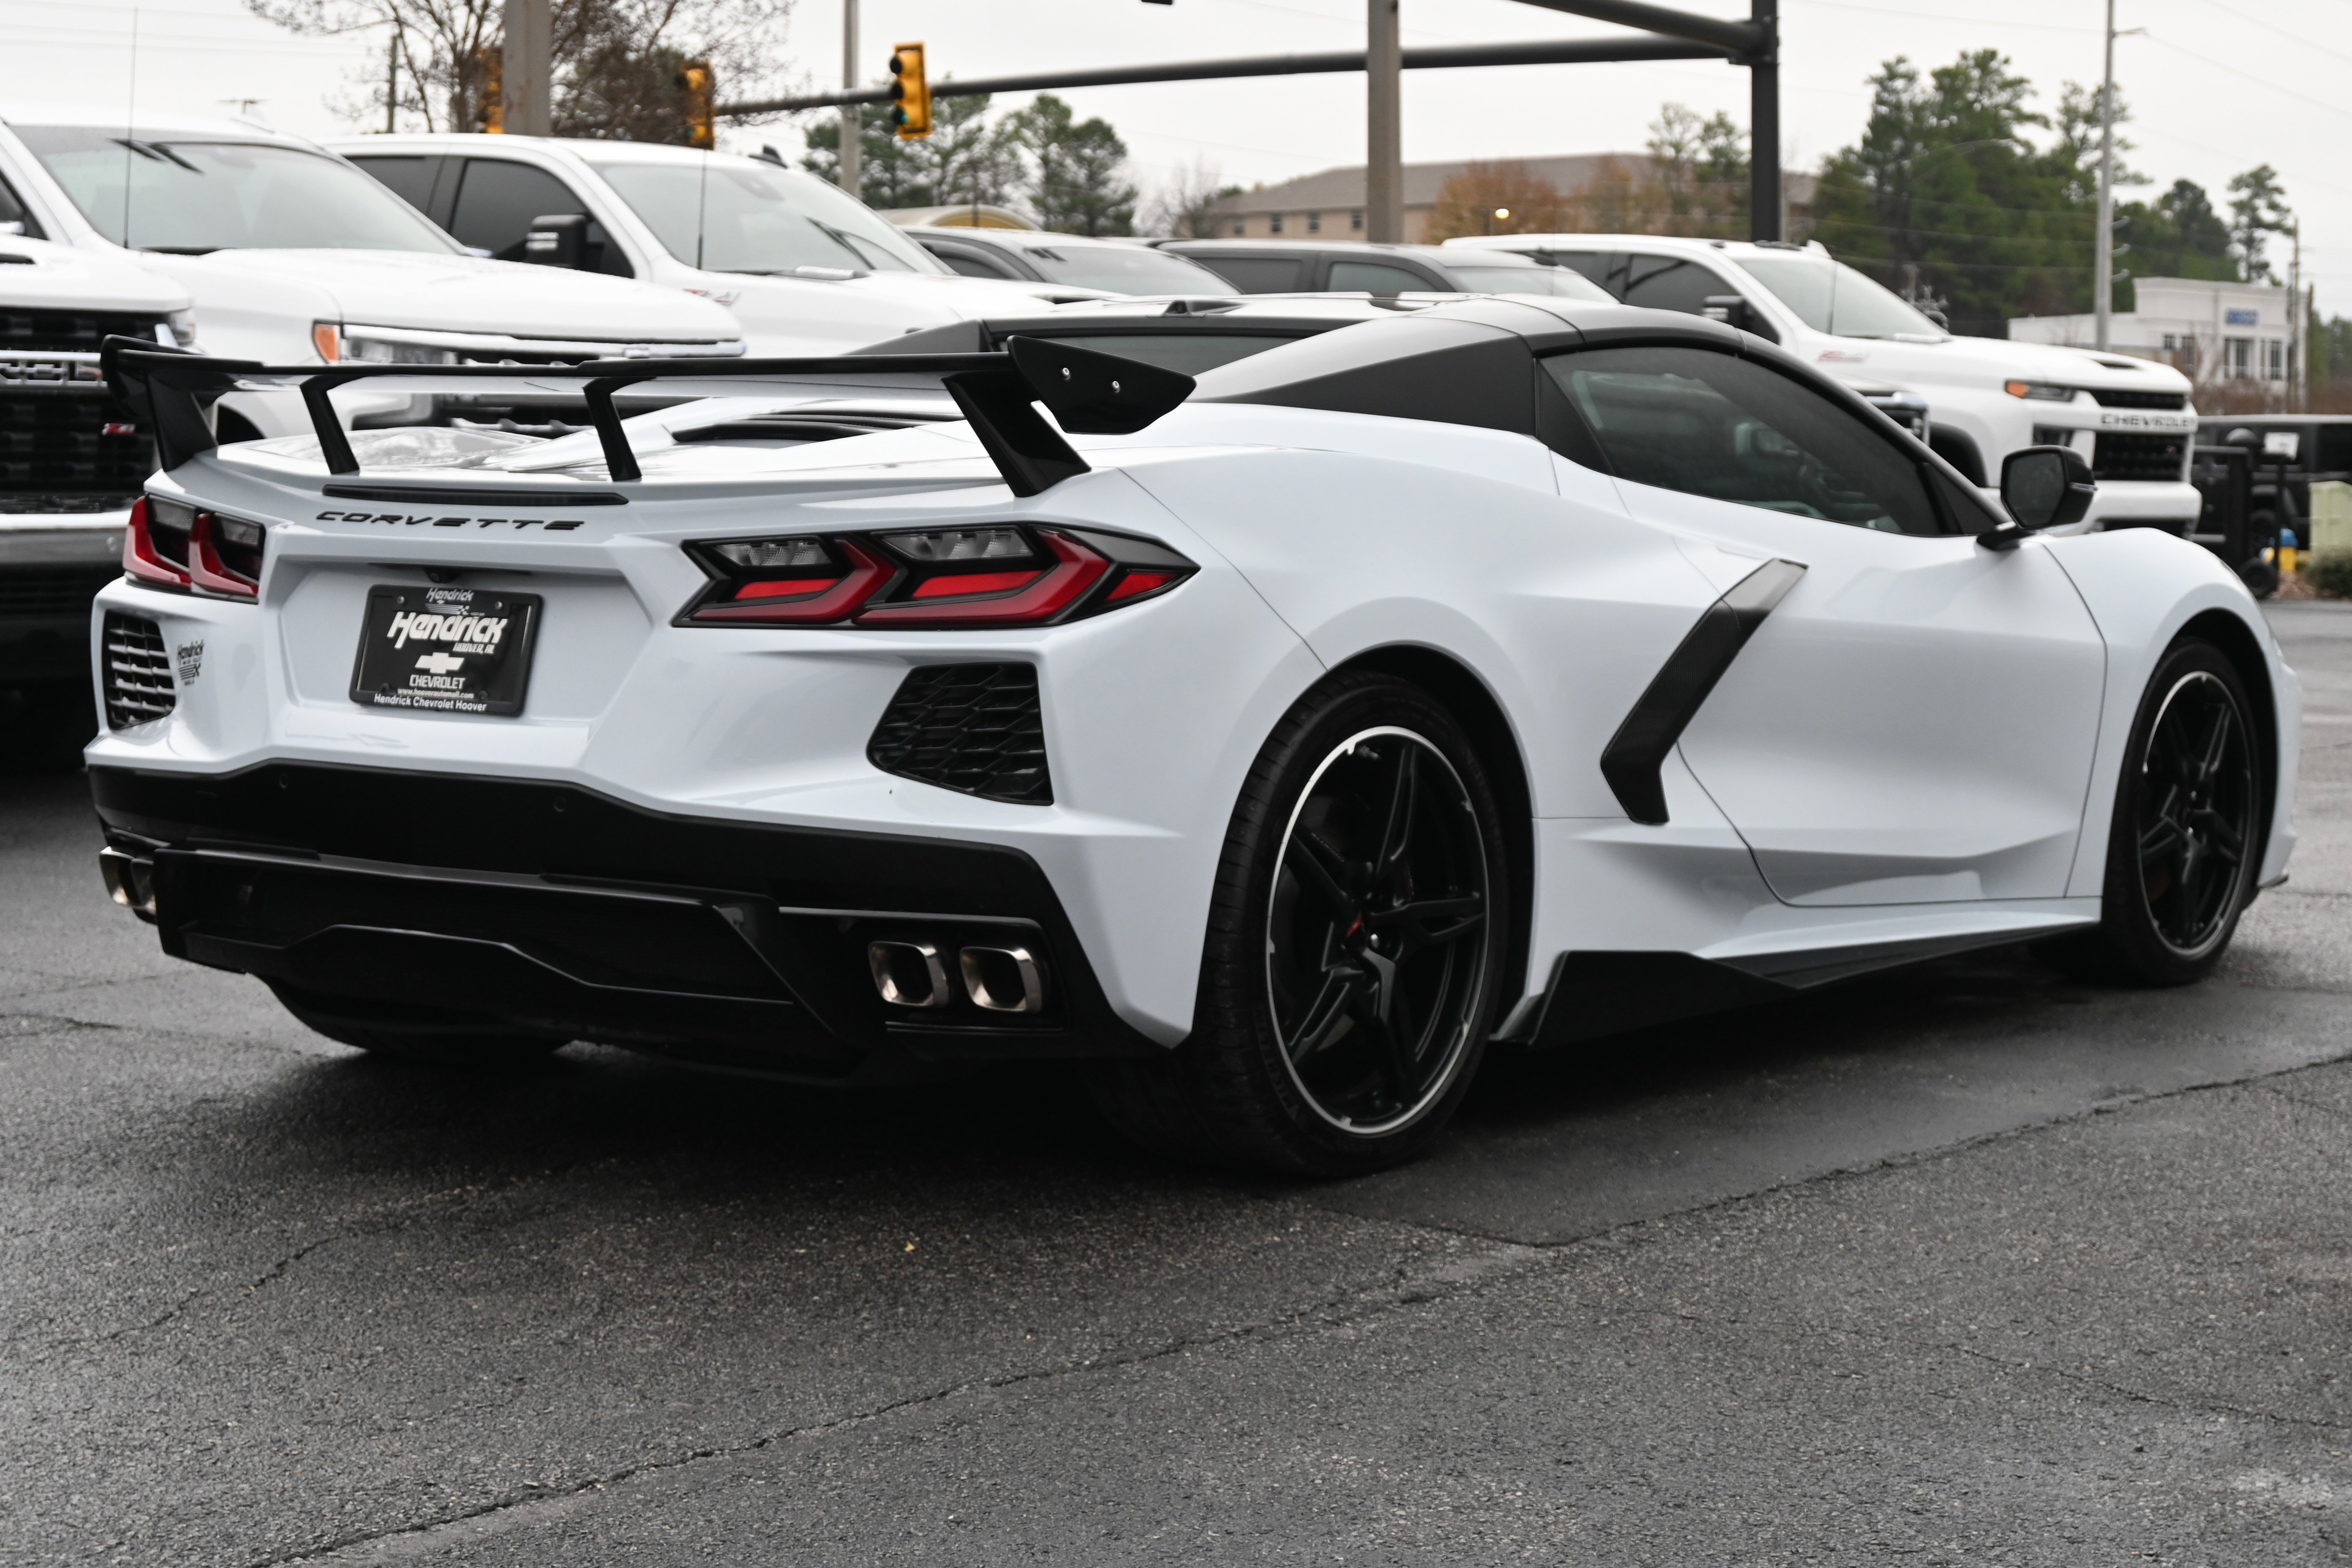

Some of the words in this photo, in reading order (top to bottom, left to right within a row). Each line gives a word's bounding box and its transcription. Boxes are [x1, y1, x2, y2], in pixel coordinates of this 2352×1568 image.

[316, 510, 584, 530] CORVETTE
[426, 588, 474, 602] Hendrick
[387, 611, 508, 649] Hendrick
[452, 643, 484, 653] HOOVER,
[485, 645, 494, 654] AL
[410, 675, 466, 689] CHEVROLET
[397, 688, 474, 699] www.hooverautomall.com
[374, 693, 411, 705] Hendrick
[413, 697, 454, 709] Chevrolet
[455, 701, 487, 711] Hoover
